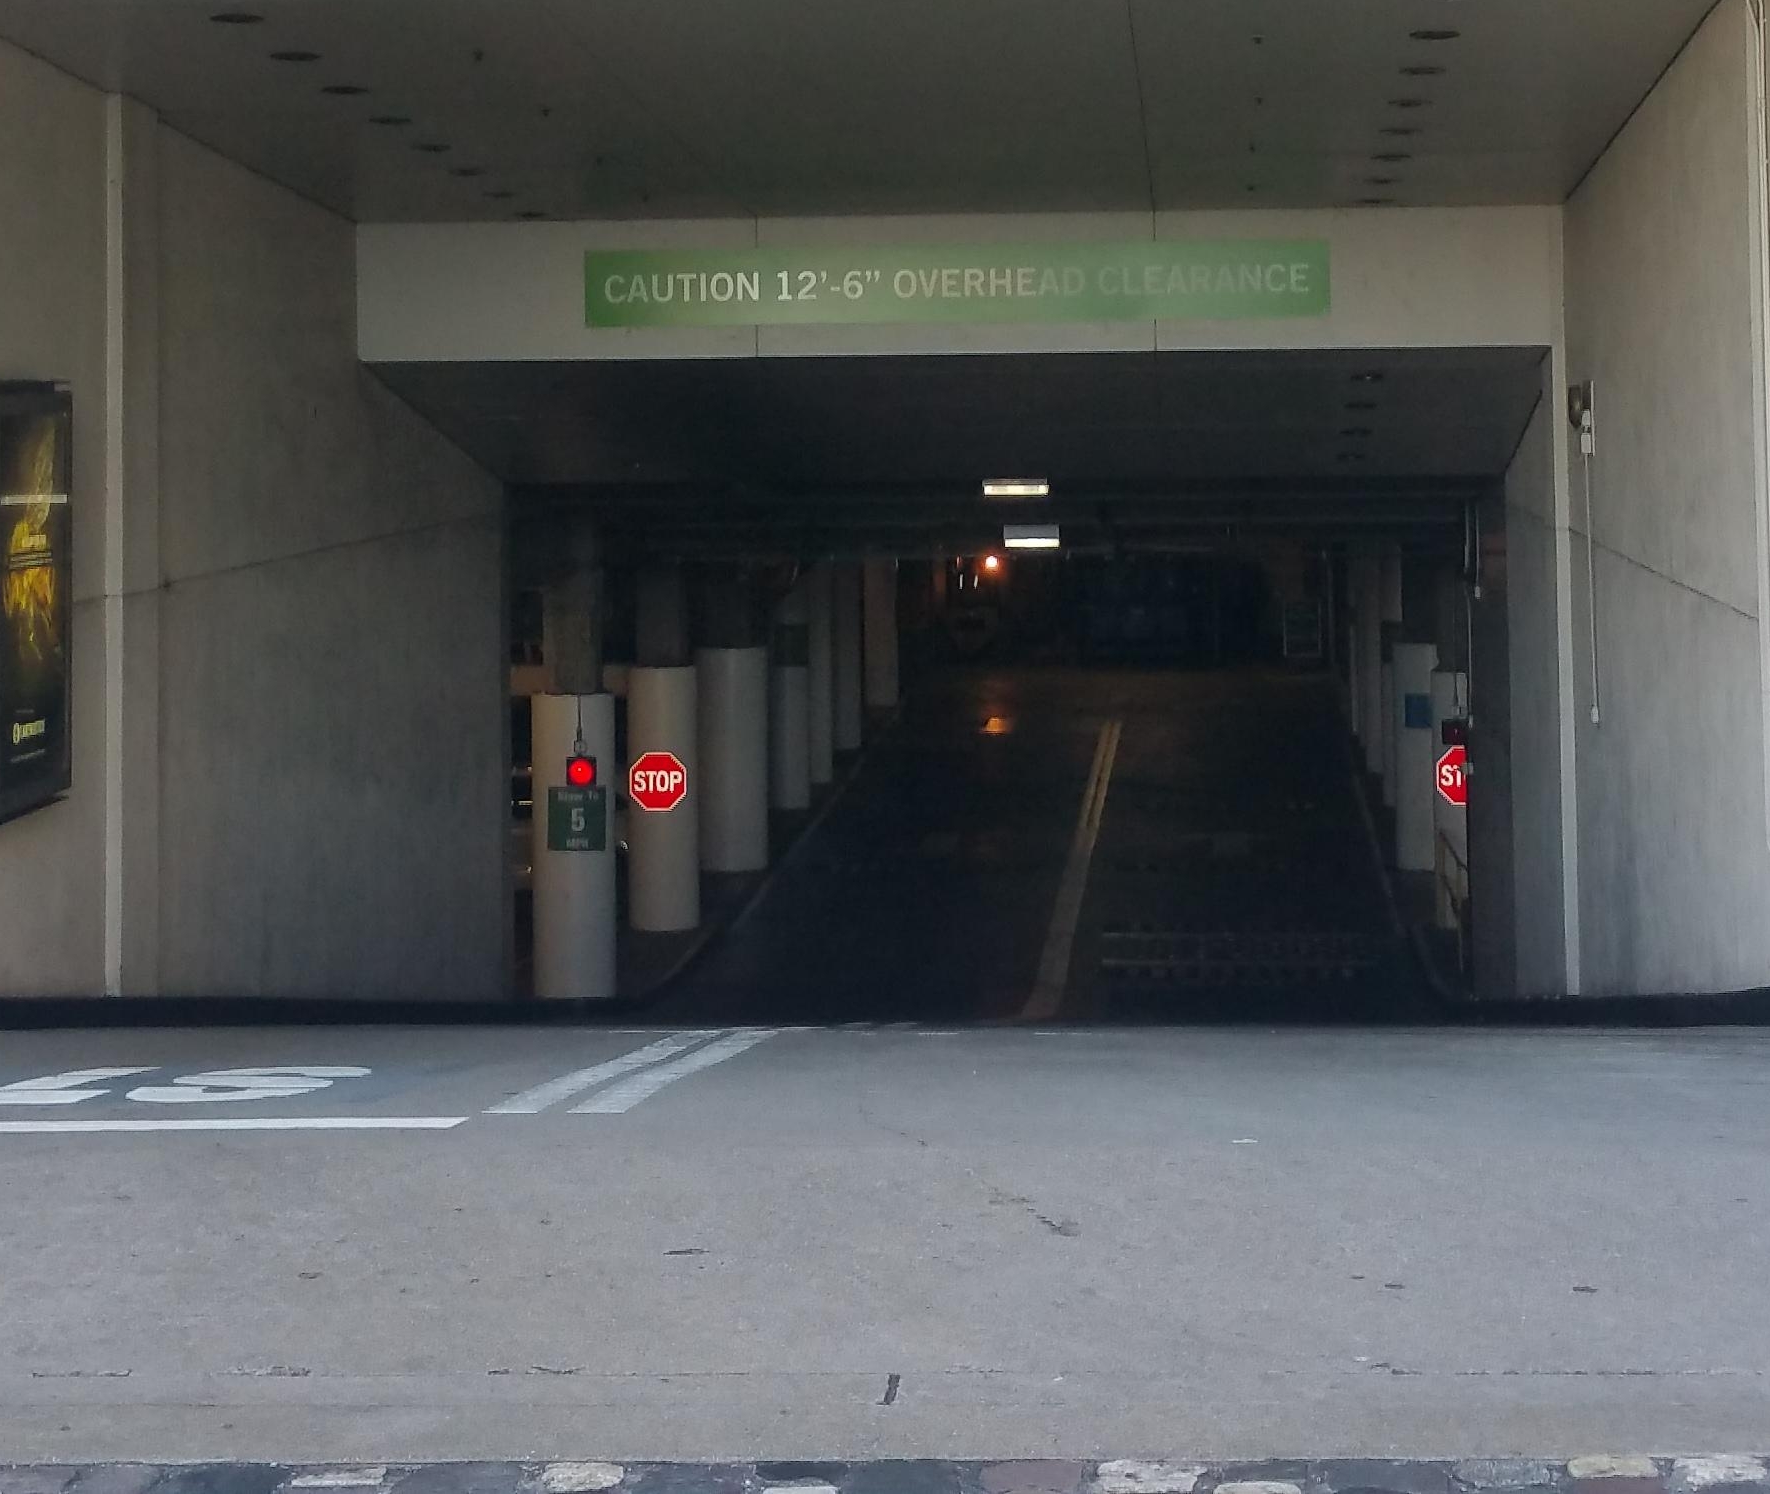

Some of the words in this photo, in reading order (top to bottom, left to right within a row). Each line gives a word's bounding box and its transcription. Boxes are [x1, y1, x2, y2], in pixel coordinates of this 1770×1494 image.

[604, 271, 760, 304] CAUTION
[893, 267, 1086, 299] OVERHEAD
[1098, 263, 1310, 296] CLEARANCE
[633, 769, 683, 794] STOP
[1440, 764, 1462, 788] ST
[571, 807, 585, 832] 5
